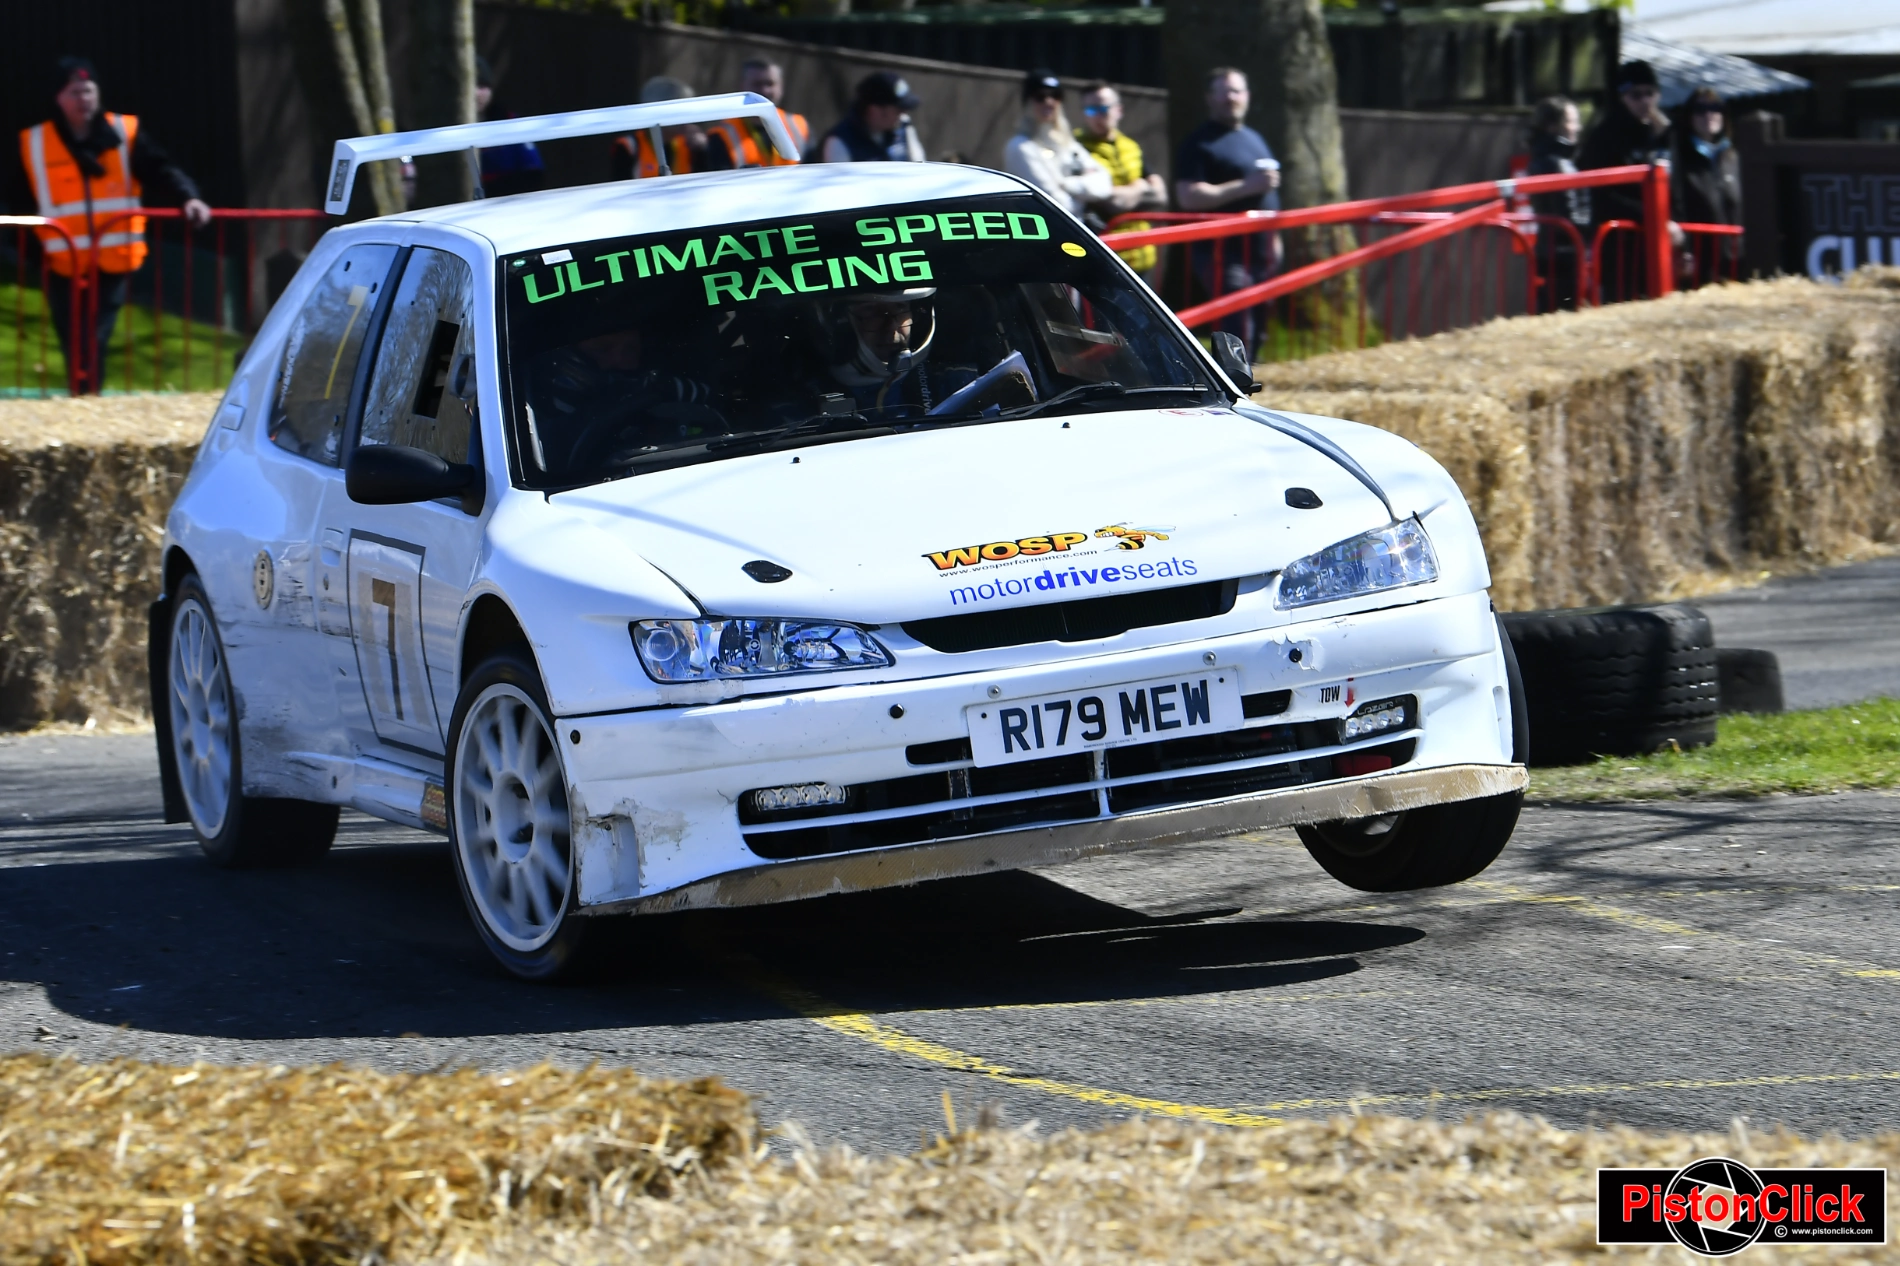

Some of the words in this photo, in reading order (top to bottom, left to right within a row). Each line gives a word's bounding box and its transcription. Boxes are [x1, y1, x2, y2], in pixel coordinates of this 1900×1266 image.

[1801, 174, 1900, 232] THE
[523, 224, 820, 303] ULTIMATE
[855, 211, 1050, 247] SPEED
[702, 250, 934, 306] RACING
[922, 532, 1088, 571] WOSP
[938, 549, 1098, 578] www.wosperformance.com
[950, 556, 1198, 605] motordriveseats
[371, 577, 405, 721] 7
[1000, 696, 1108, 753] R179
[1118, 679, 1211, 736] MEW
[1320, 685, 1341, 704] TOW
